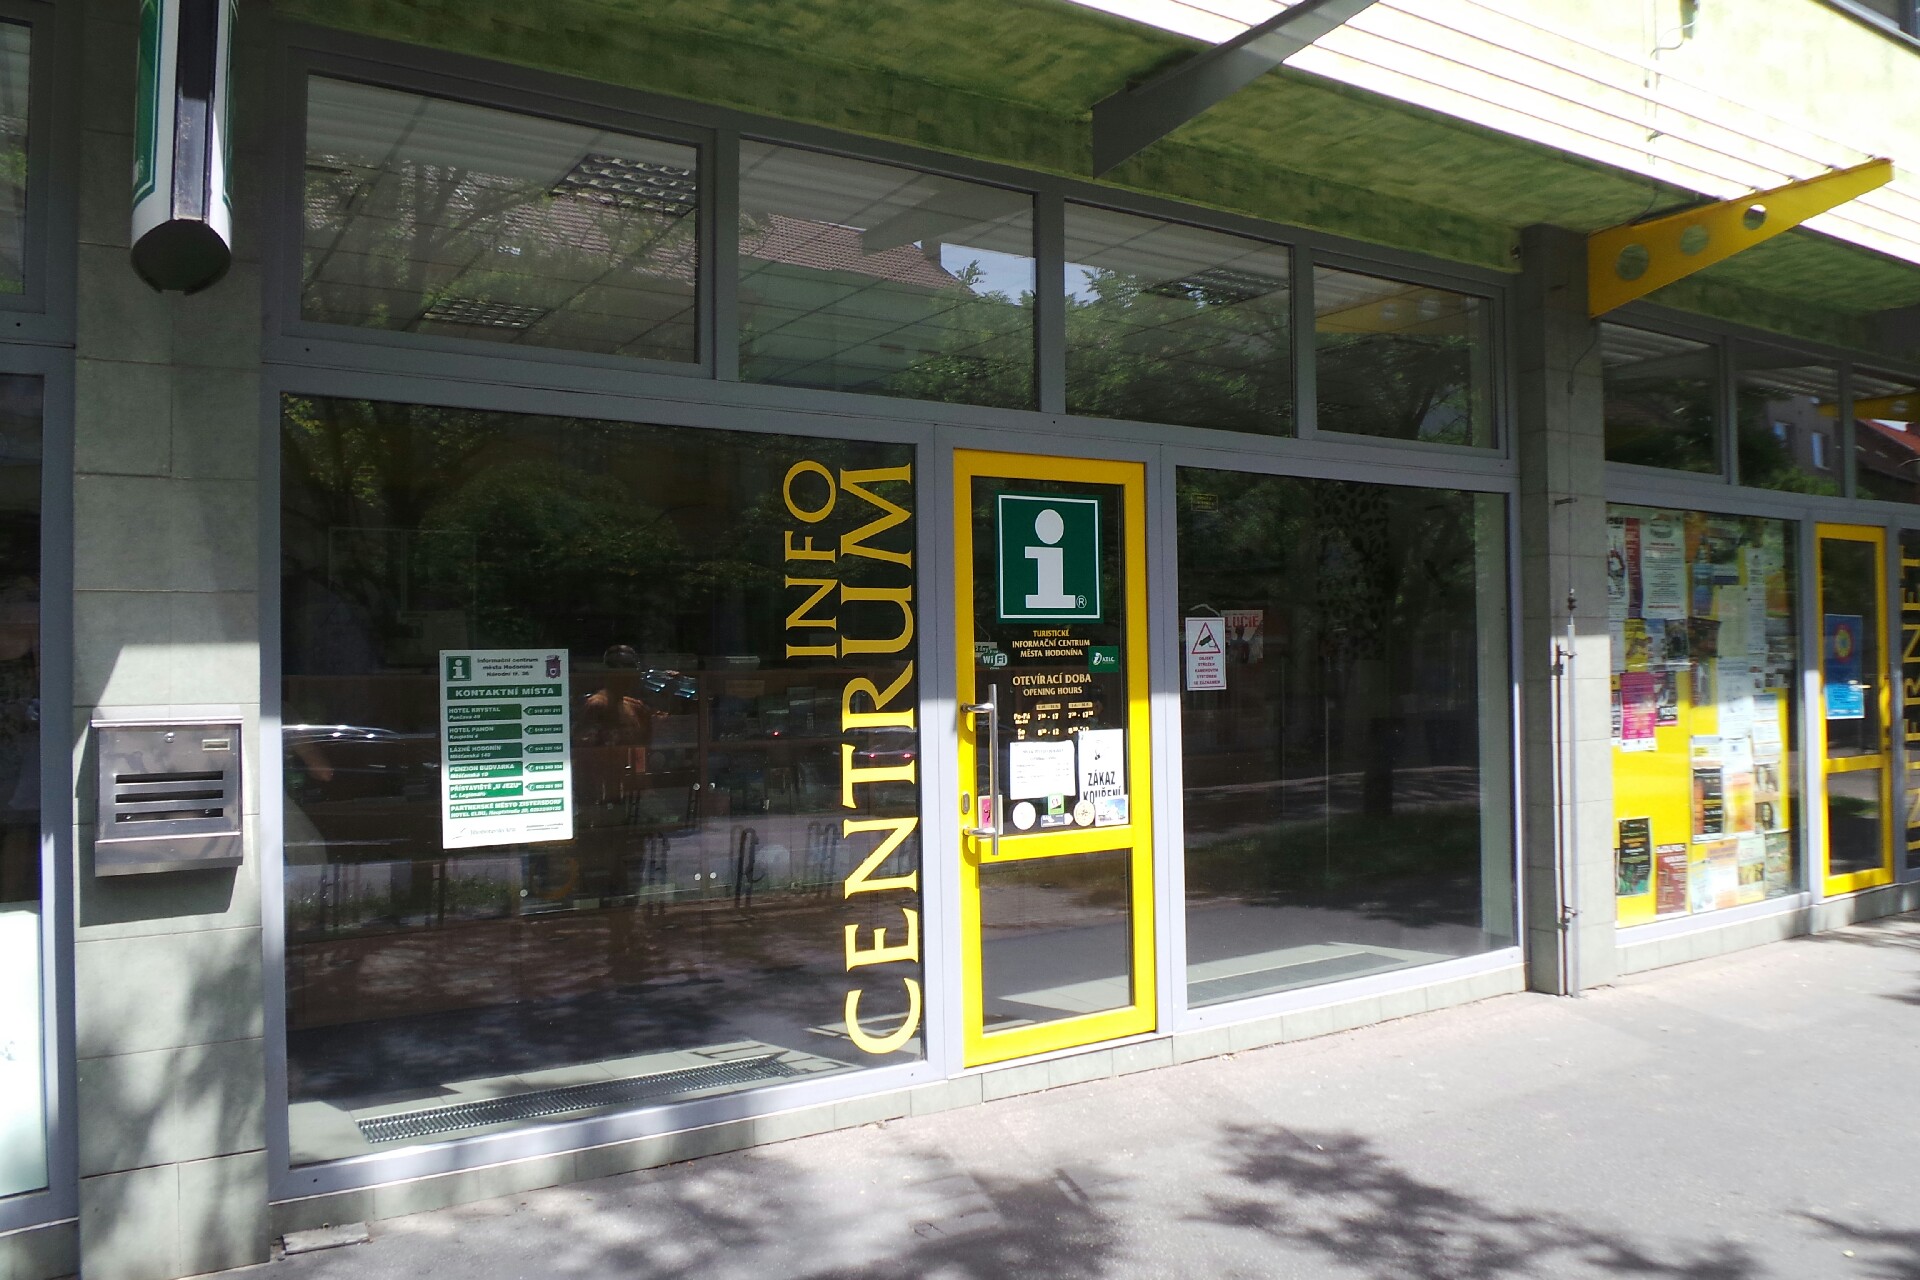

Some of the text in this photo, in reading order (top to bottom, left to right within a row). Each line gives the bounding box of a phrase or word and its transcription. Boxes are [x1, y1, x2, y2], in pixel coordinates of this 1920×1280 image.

[783, 460, 837, 659] INFO
[1033, 629, 1070, 638] TURISTICKÉ
[1012, 639, 1057, 648] INFORMAČNÍ
[1020, 648, 1083, 658] MĚSTA HODONÍNA
[1012, 673, 1092, 686] OTEVÍRACÍ DOBA
[455, 686, 554, 697] KONTAKTNÍ MÍSTA
[1023, 686, 1083, 696] OPENING HOURS
[449, 745, 471, 753] LÁZNĚ
[840, 463, 921, 1054] CENTRUM
[1087, 769, 1116, 786] ZÁKAZ
[450, 783, 491, 792] PŘÍSTAVIŠTĚ
[450, 803, 494, 811] PARTNERSKÉ
[518, 799, 562, 807] ZISTERSDORF
